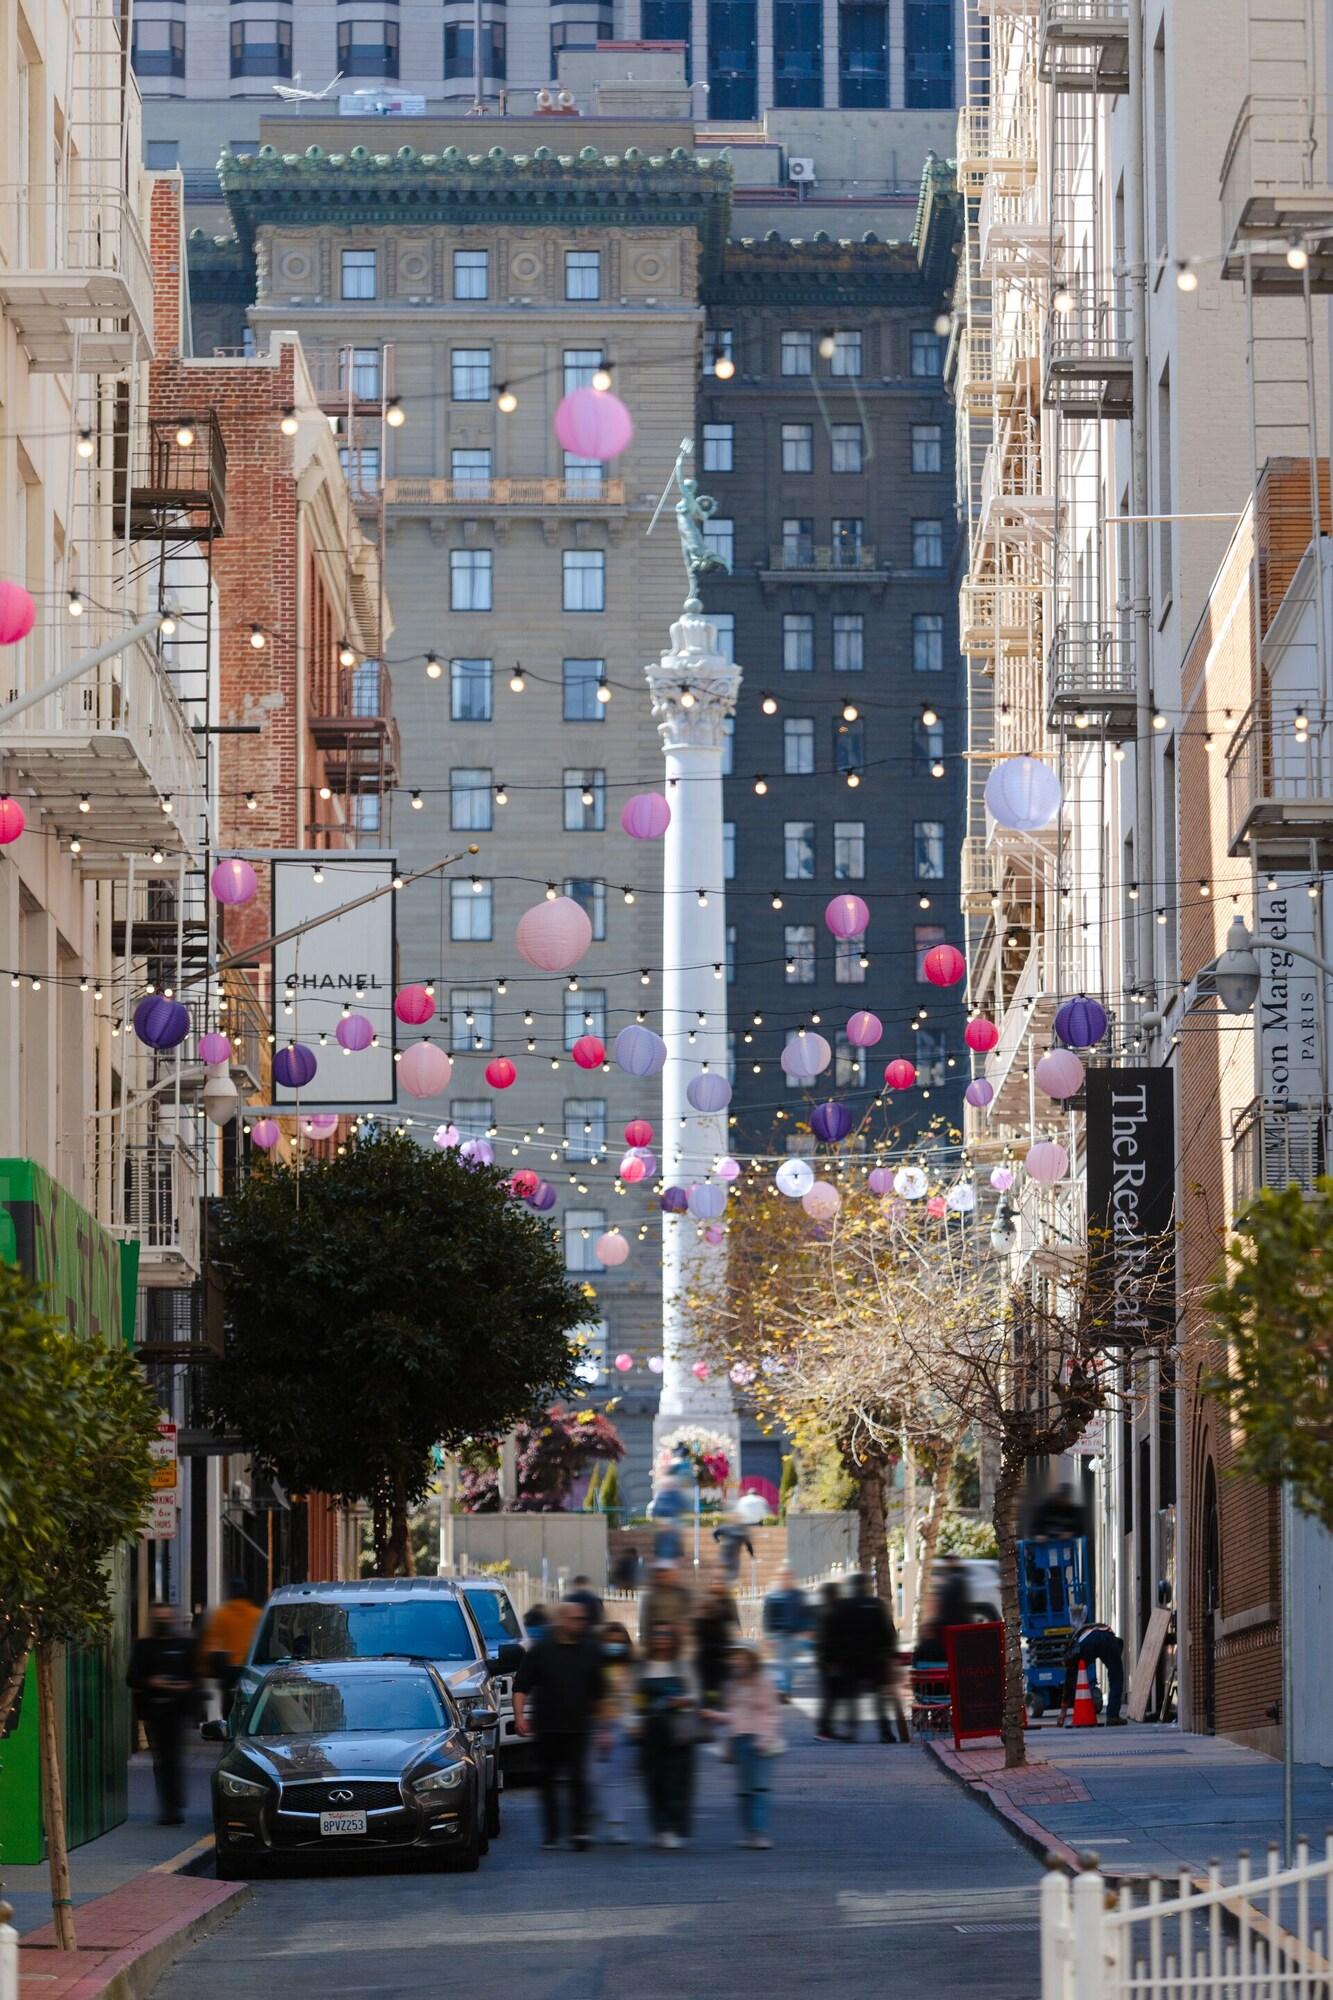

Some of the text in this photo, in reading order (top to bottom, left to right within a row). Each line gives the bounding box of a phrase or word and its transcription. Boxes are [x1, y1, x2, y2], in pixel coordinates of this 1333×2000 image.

[285, 973, 382, 989] CHANEL
[1261, 898, 1293, 1033] Margela
[1301, 992, 1315, 1061] PARIS
[323, 1819, 364, 1831] 8PVZ253
